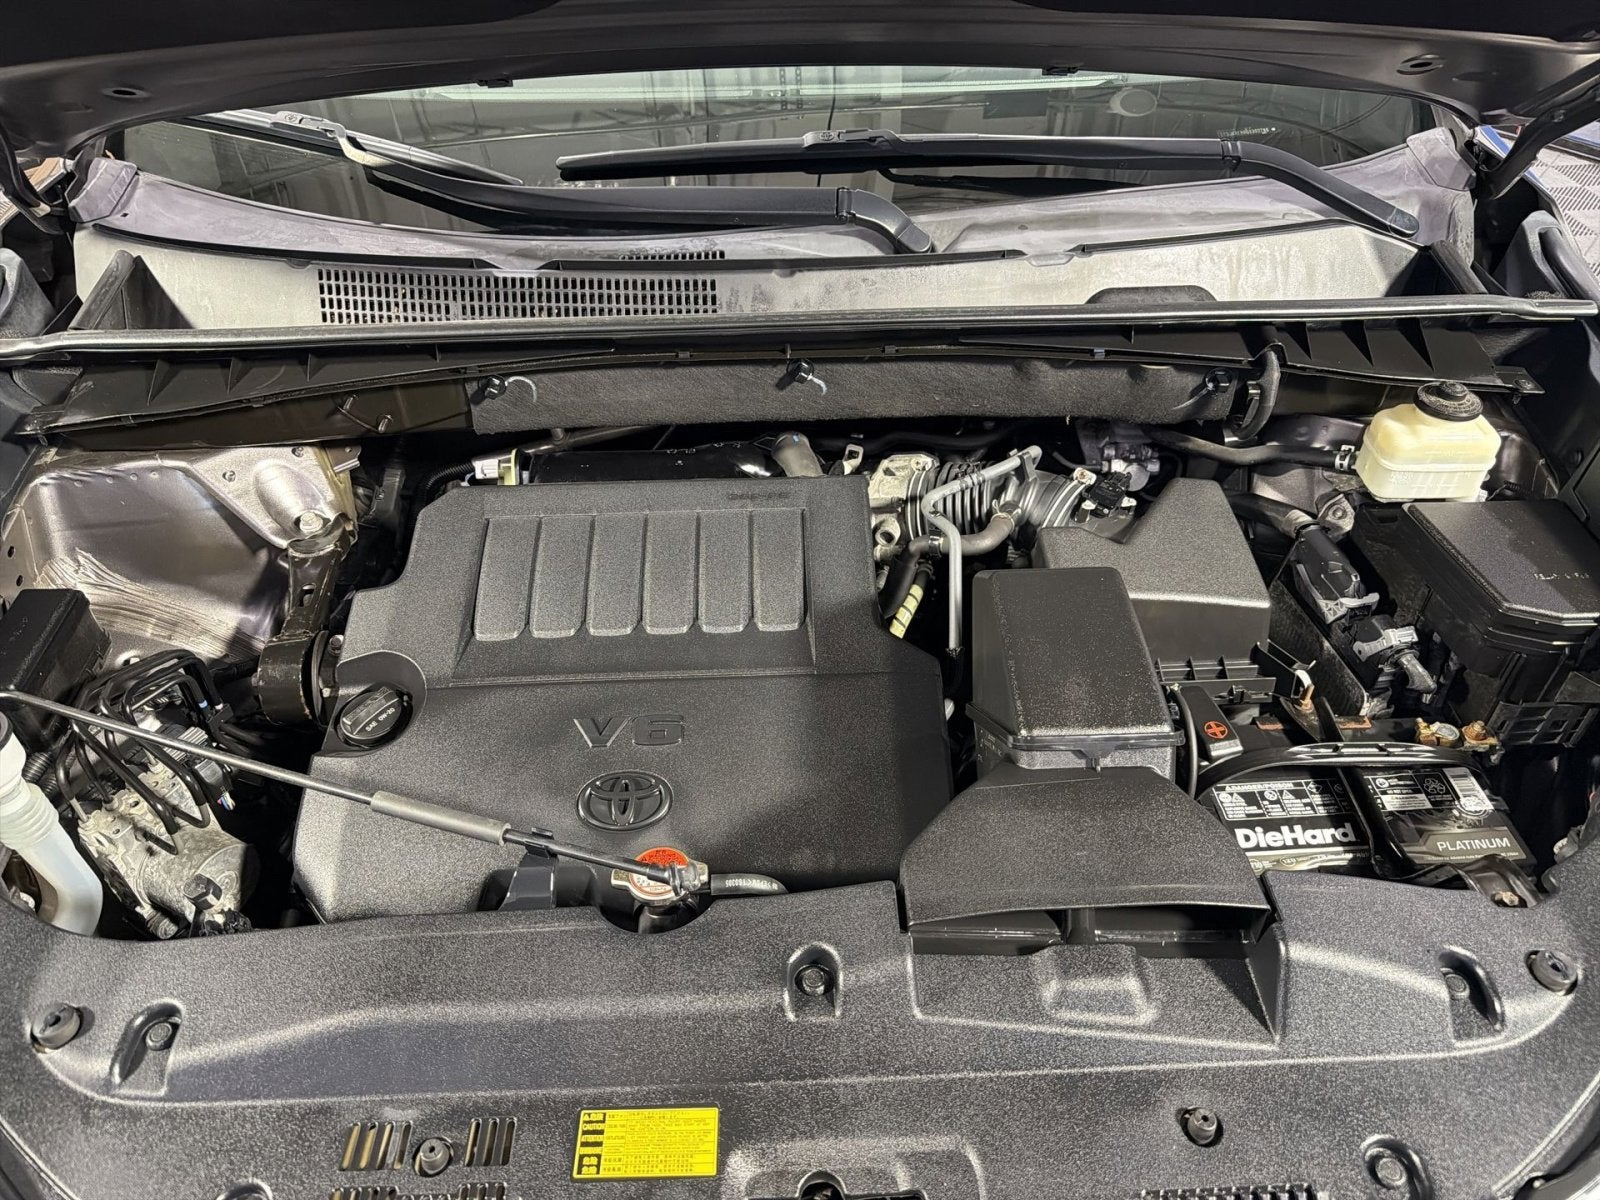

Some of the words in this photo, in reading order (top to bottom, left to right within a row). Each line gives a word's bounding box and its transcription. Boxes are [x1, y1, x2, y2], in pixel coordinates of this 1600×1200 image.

[366, 721, 378, 731] SAE
[573, 714, 685, 748] V6
[1234, 822, 1356, 849] DieHard
[1437, 837, 1511, 852] PLATINUM
